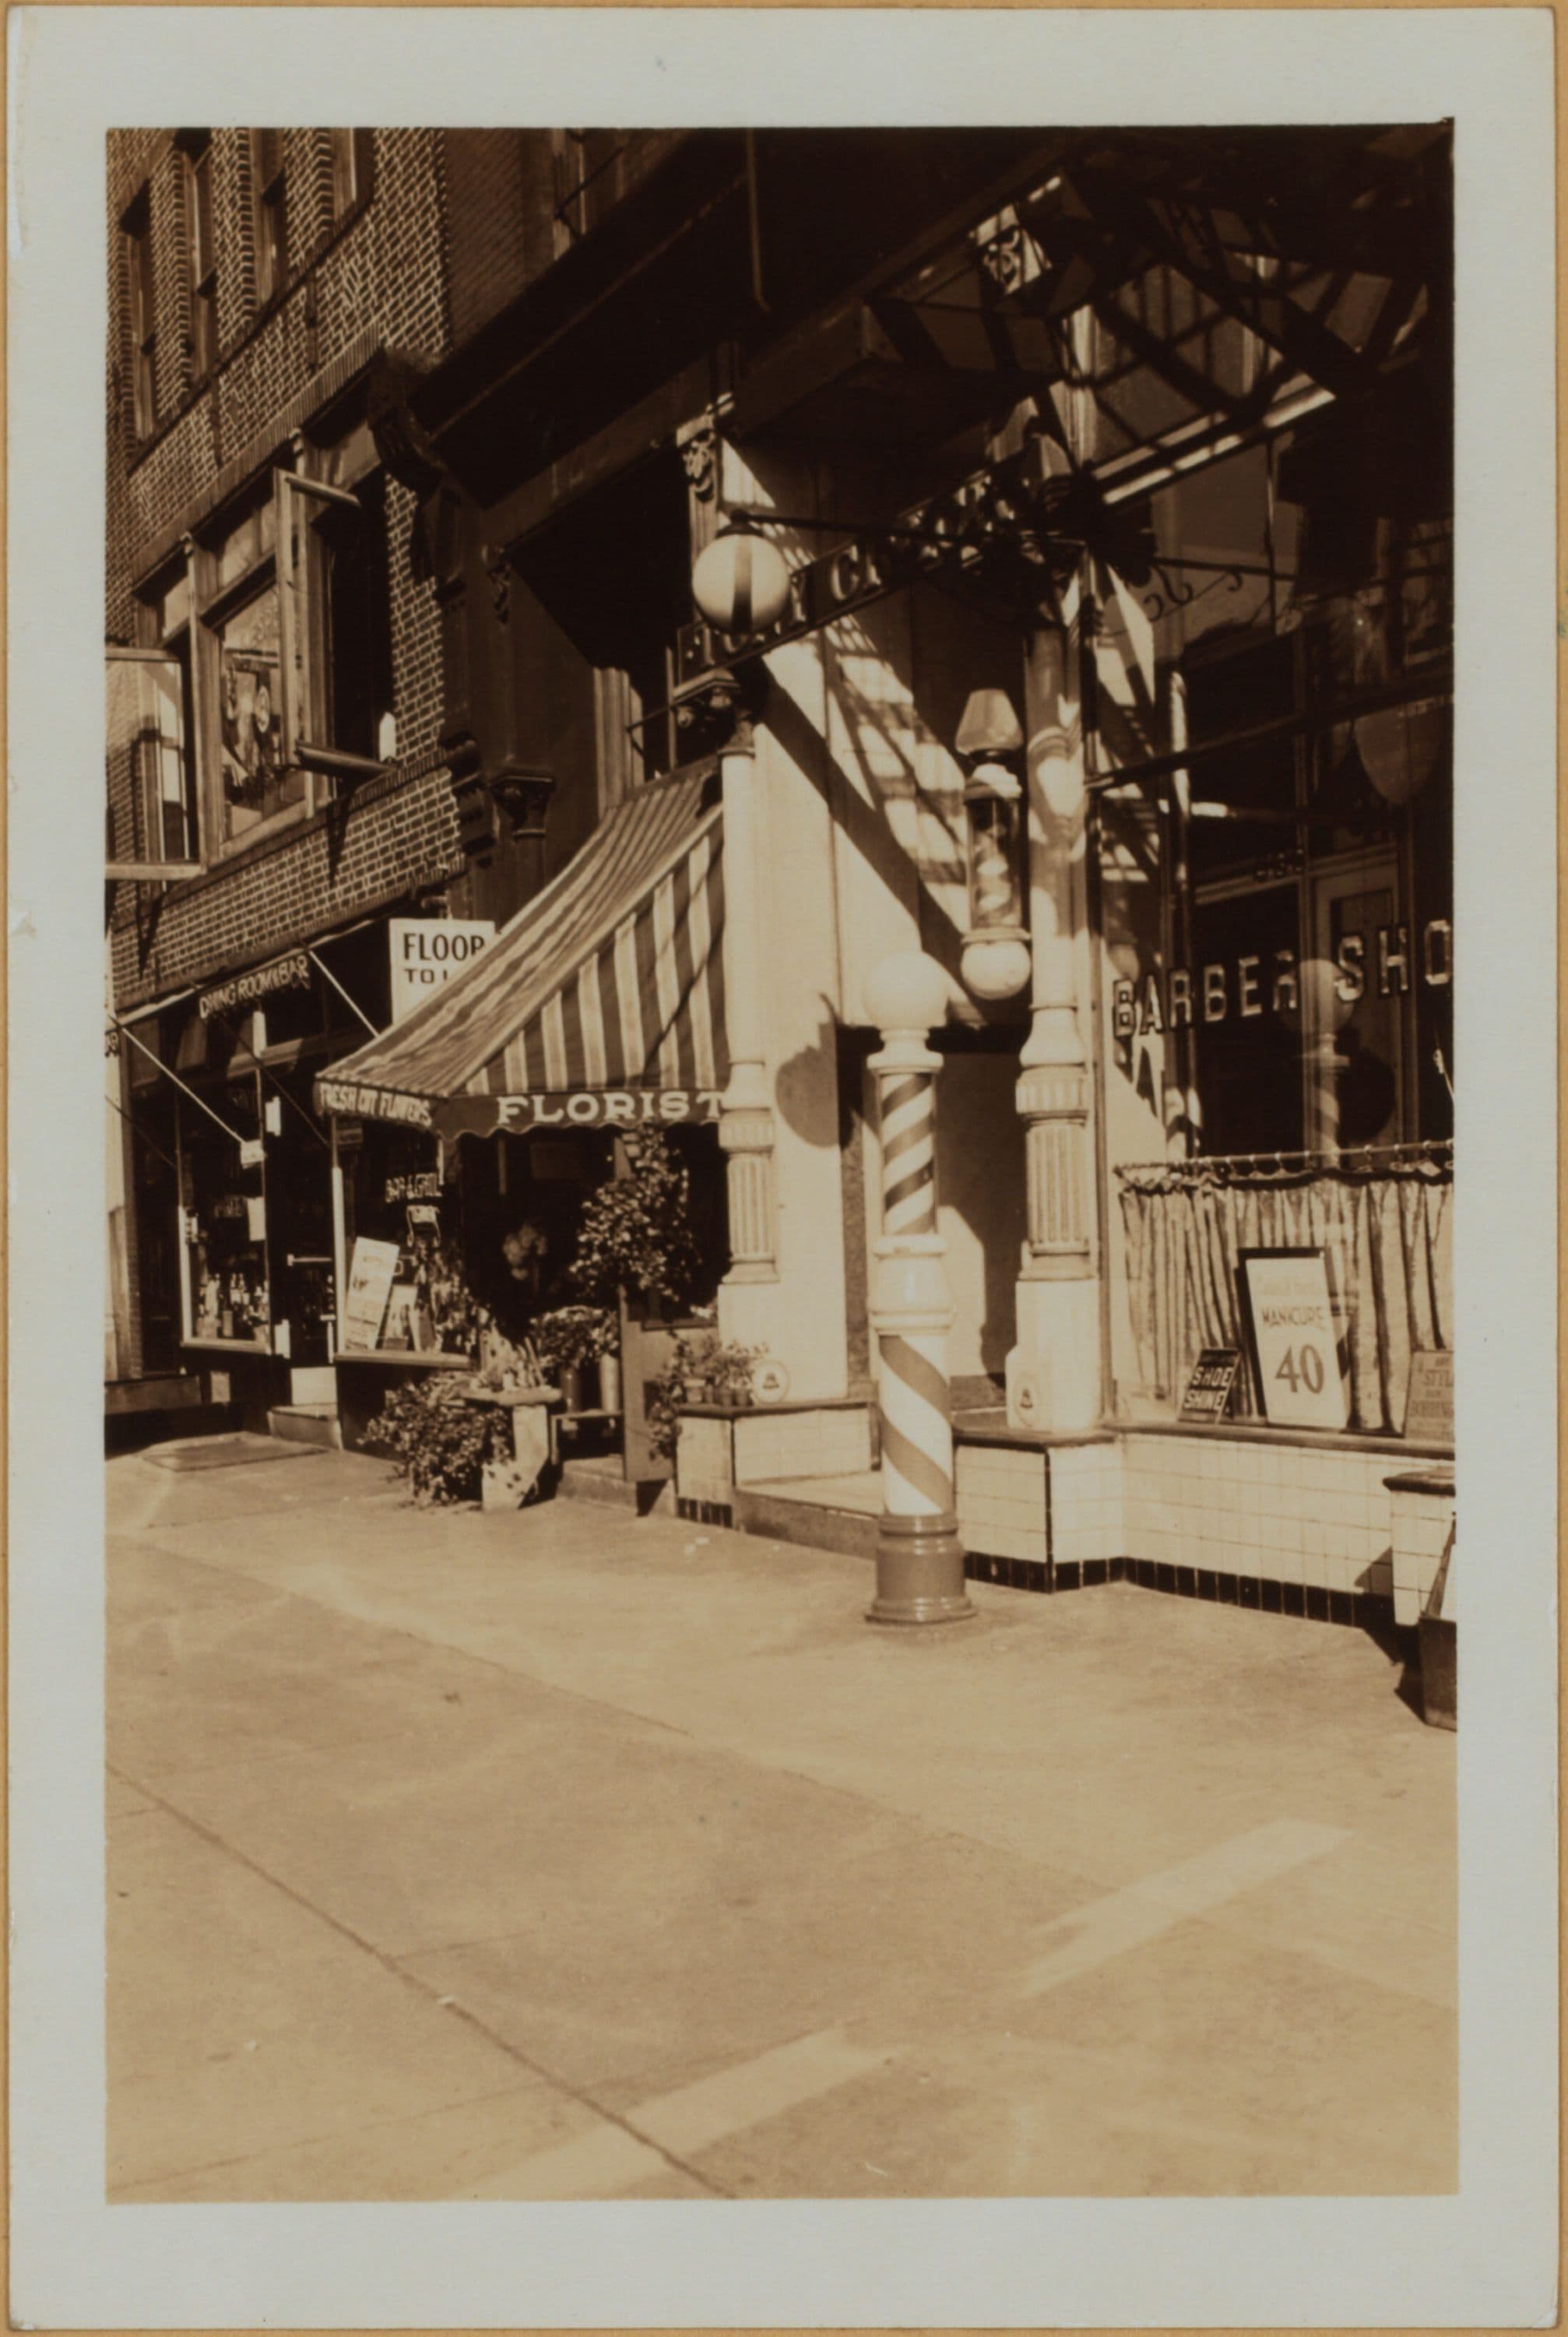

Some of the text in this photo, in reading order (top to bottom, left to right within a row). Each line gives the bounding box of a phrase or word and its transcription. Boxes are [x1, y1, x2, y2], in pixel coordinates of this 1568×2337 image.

[198, 983, 235, 1019] DINING
[237, 970, 271, 1001] ROOM
[277, 954, 310, 990] BAR
[403, 968, 434, 984] TO
[1112, 919, 1452, 1038] BARBER SHO
[319, 1082, 357, 1112] FRESH
[378, 1091, 433, 1127] FLOWERS
[495, 1091, 724, 1125] FLORIST
[385, 1176, 406, 1204] BAR
[1260, 1305, 1327, 1332] MANICURE
[1190, 1365, 1236, 1388] SHOE
[1274, 1343, 1325, 1394] 40
[1182, 1388, 1228, 1411] SHINE
